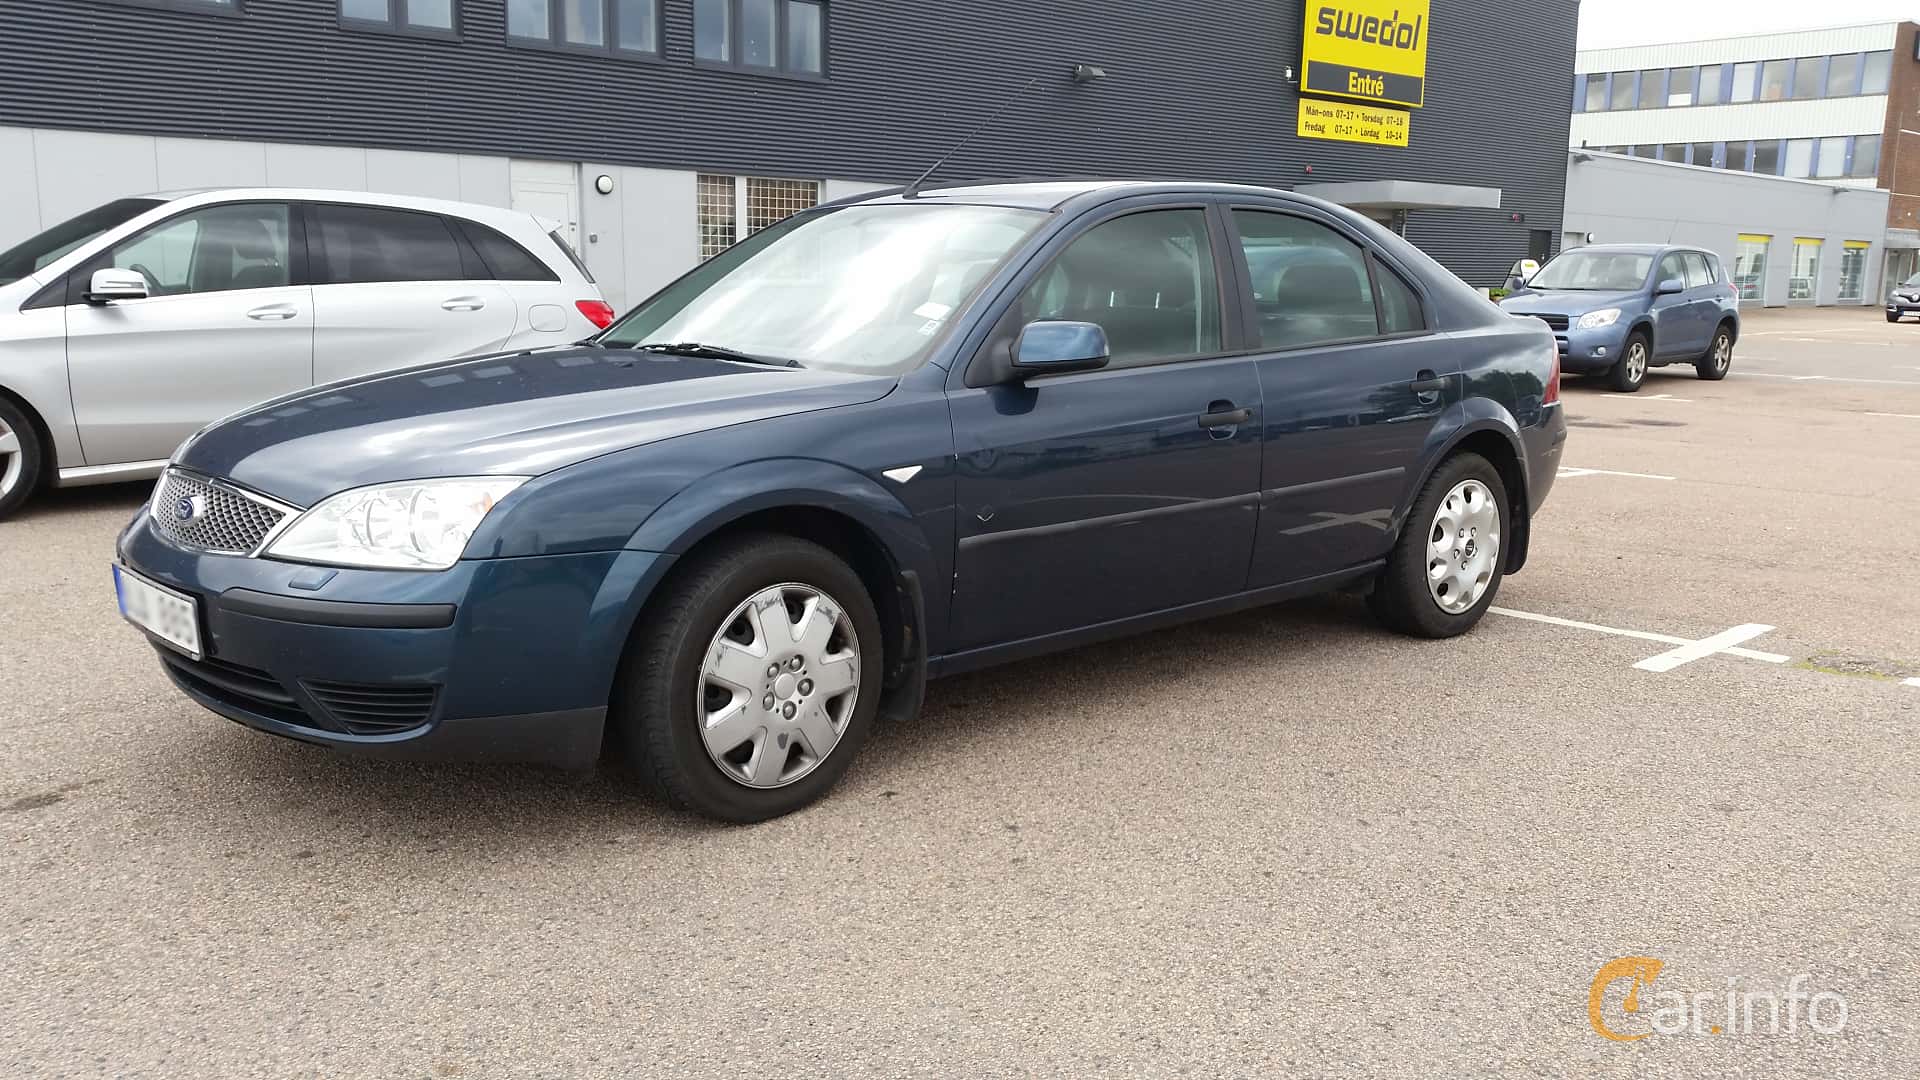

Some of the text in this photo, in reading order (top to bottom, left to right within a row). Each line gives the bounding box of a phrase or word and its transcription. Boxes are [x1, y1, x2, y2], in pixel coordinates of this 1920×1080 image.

[1316, 6, 1422, 51] swedol
[1348, 71, 1384, 96] Entré
[1305, 105, 1333, 118] Mån-ons
[1335, 109, 1354, 120] 07-17
[1361, 112, 1383, 126] Torsdag
[1304, 121, 1326, 134] Fredag
[1334, 124, 1353, 135] 07-17
